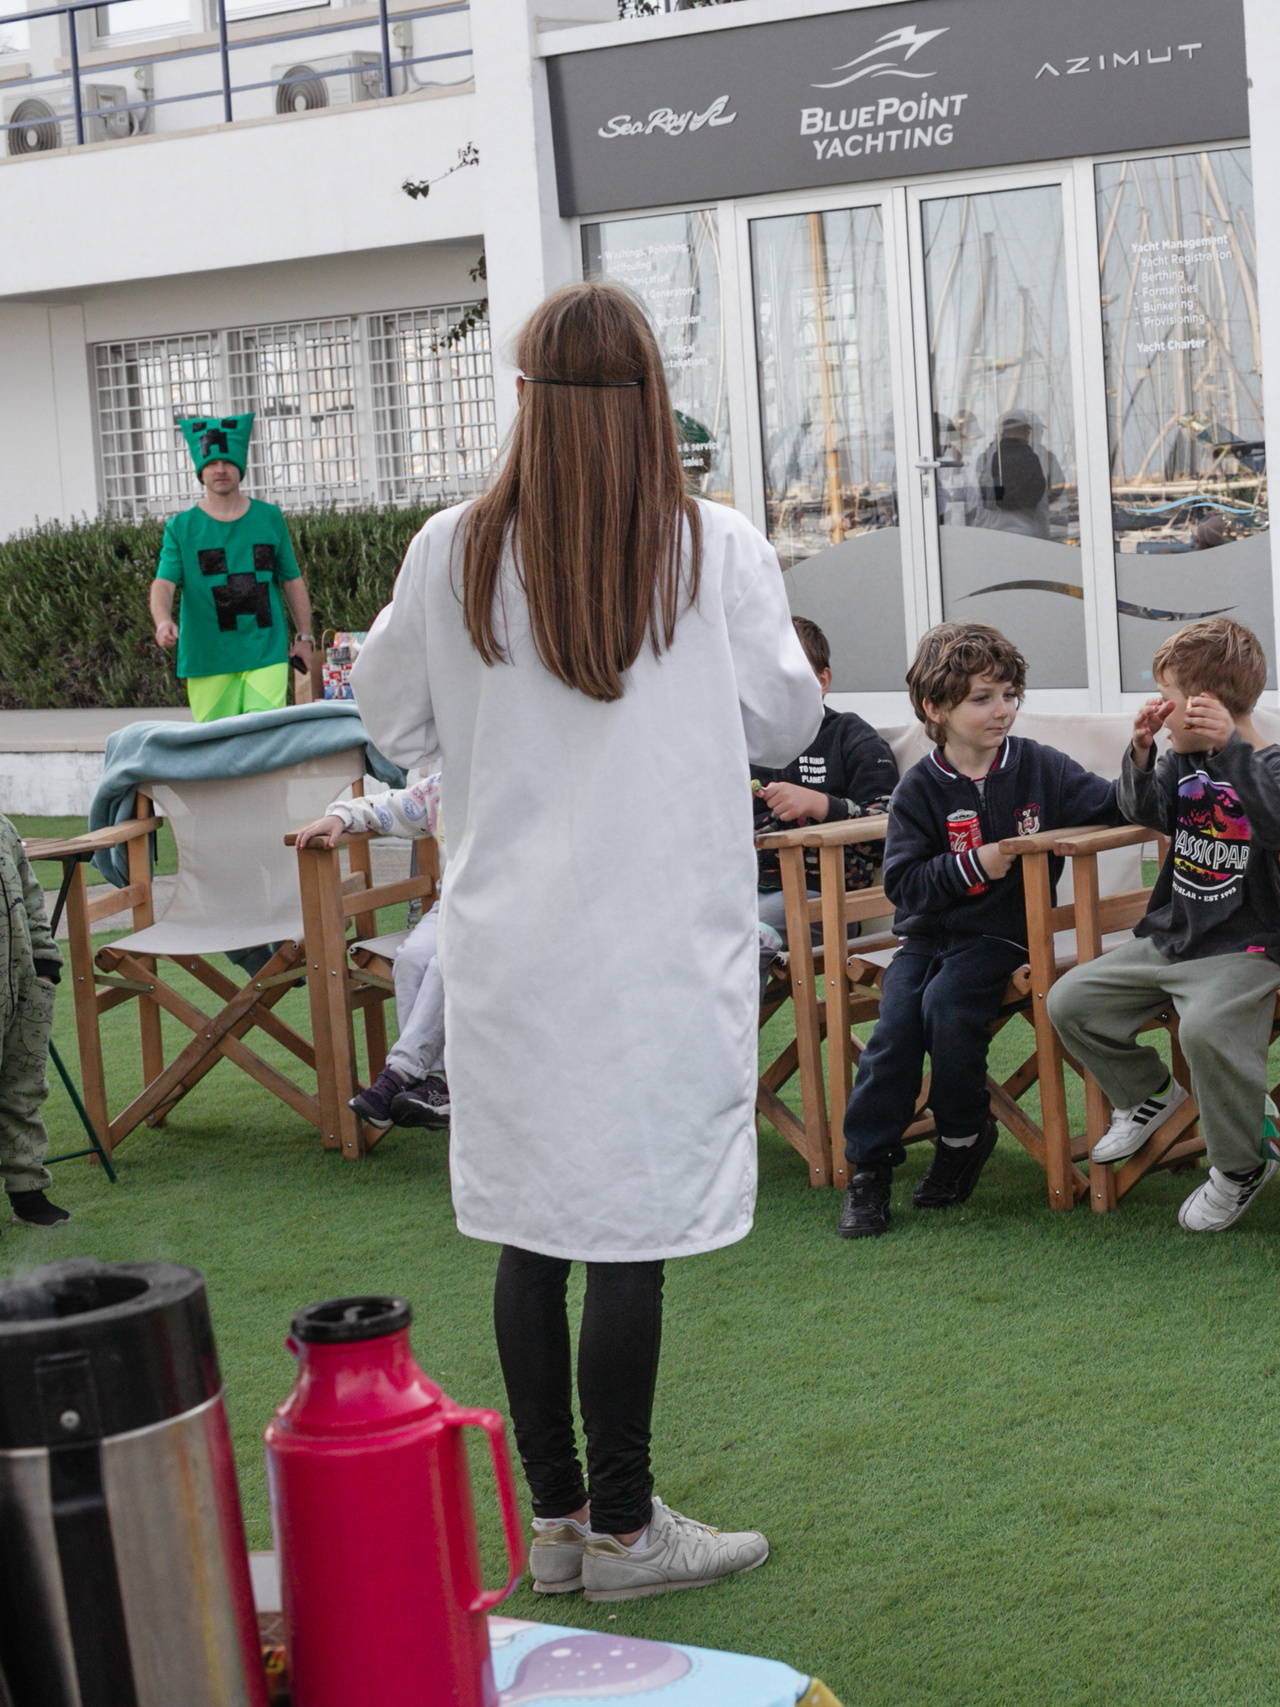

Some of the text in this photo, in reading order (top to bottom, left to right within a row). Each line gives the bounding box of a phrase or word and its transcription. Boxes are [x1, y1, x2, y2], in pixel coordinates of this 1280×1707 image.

[1035, 43, 1202, 80] AZIMUT
[598, 107, 694, 139] Sea Ray
[812, 123, 954, 161] YACHTING
[1131, 234, 1228, 253] Yacht Management
[1141, 250, 1233, 267] Yacht Registration
[1141, 269, 1185, 283] Berthing
[1142, 283, 1199, 298] Formalities
[1143, 300, 1194, 313] Bunkering
[1144, 313, 1206, 328] Provisioning
[1136, 337, 1207, 354] Yacht Charter
[799, 755, 825, 764] BE KIND
[809, 766, 827, 774] YOUR
[801, 775, 826, 784] PLANET
[1212, 841, 1251, 870] PAR
[1203, 893, 1219, 902] EST
